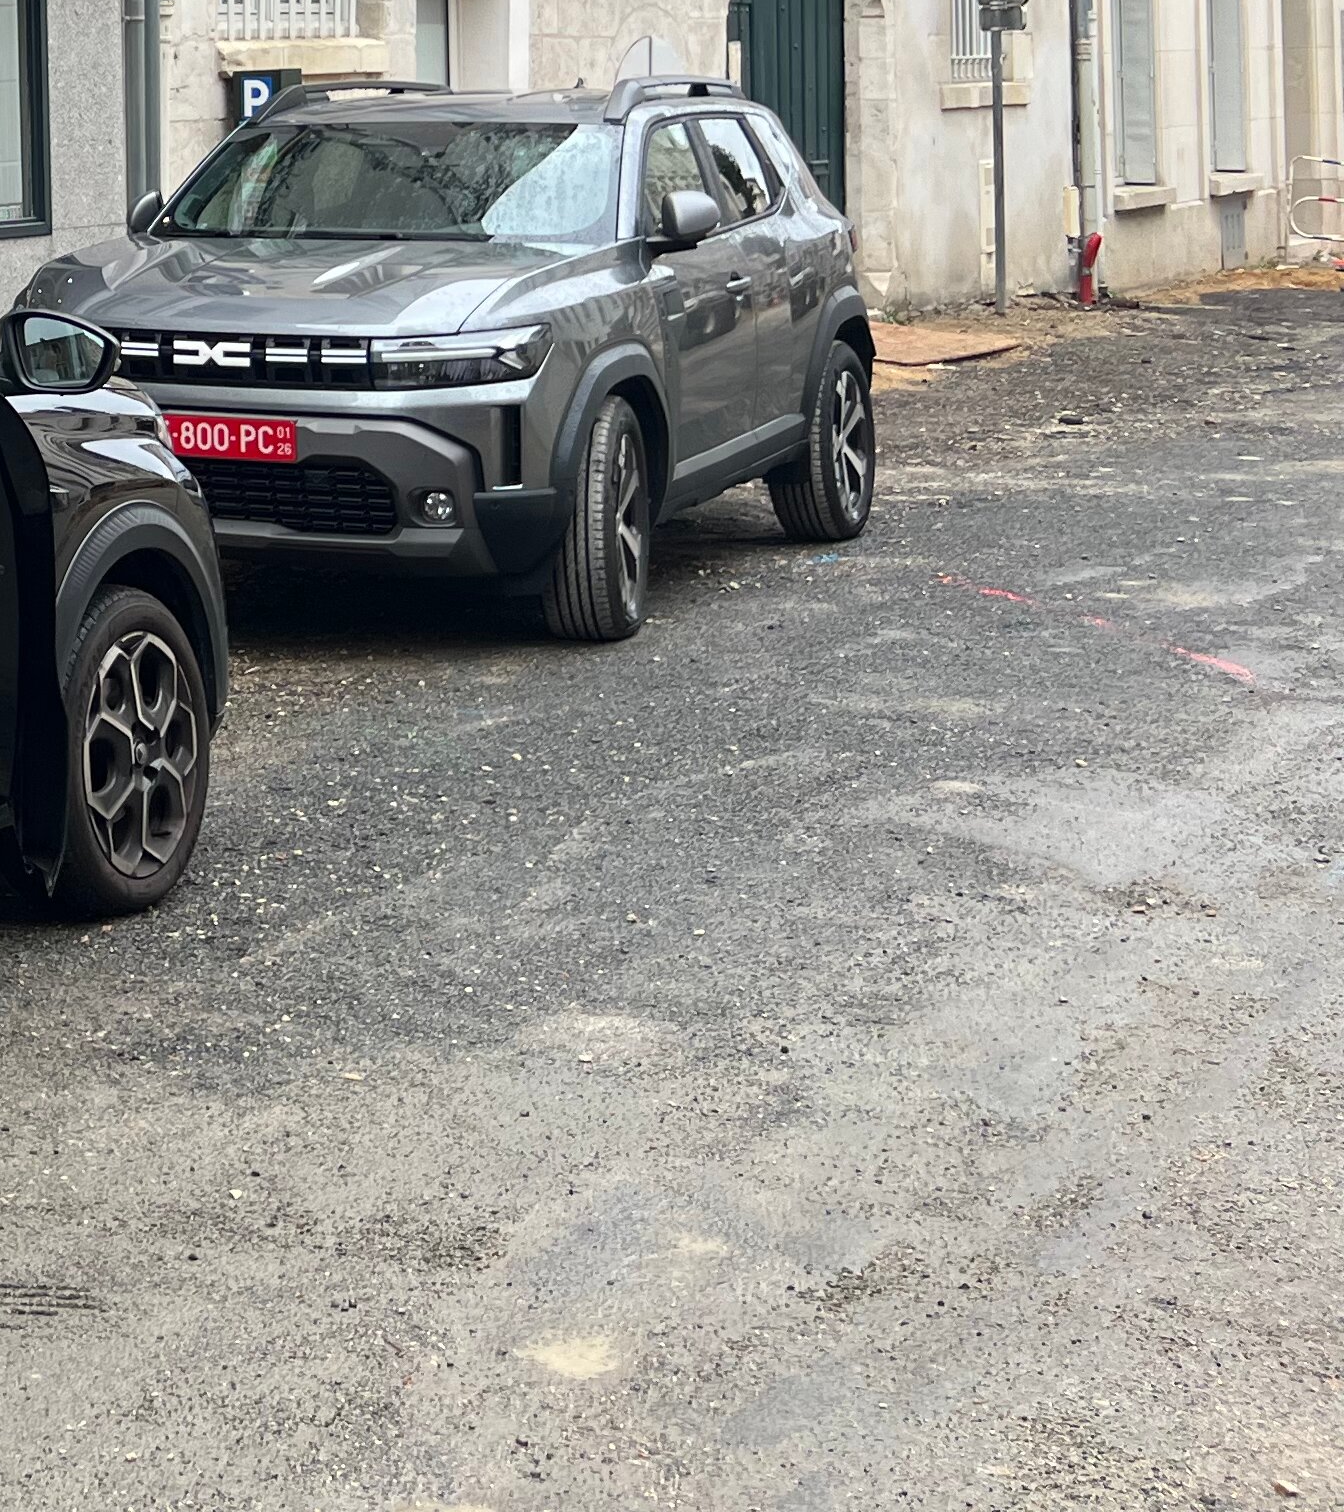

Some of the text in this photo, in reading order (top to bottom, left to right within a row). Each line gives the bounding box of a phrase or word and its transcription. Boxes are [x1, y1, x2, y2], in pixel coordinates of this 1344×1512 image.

[243, 78, 270, 118] P
[164, 419, 291, 455] -800-PC 01
[276, 442, 293, 456] 26
